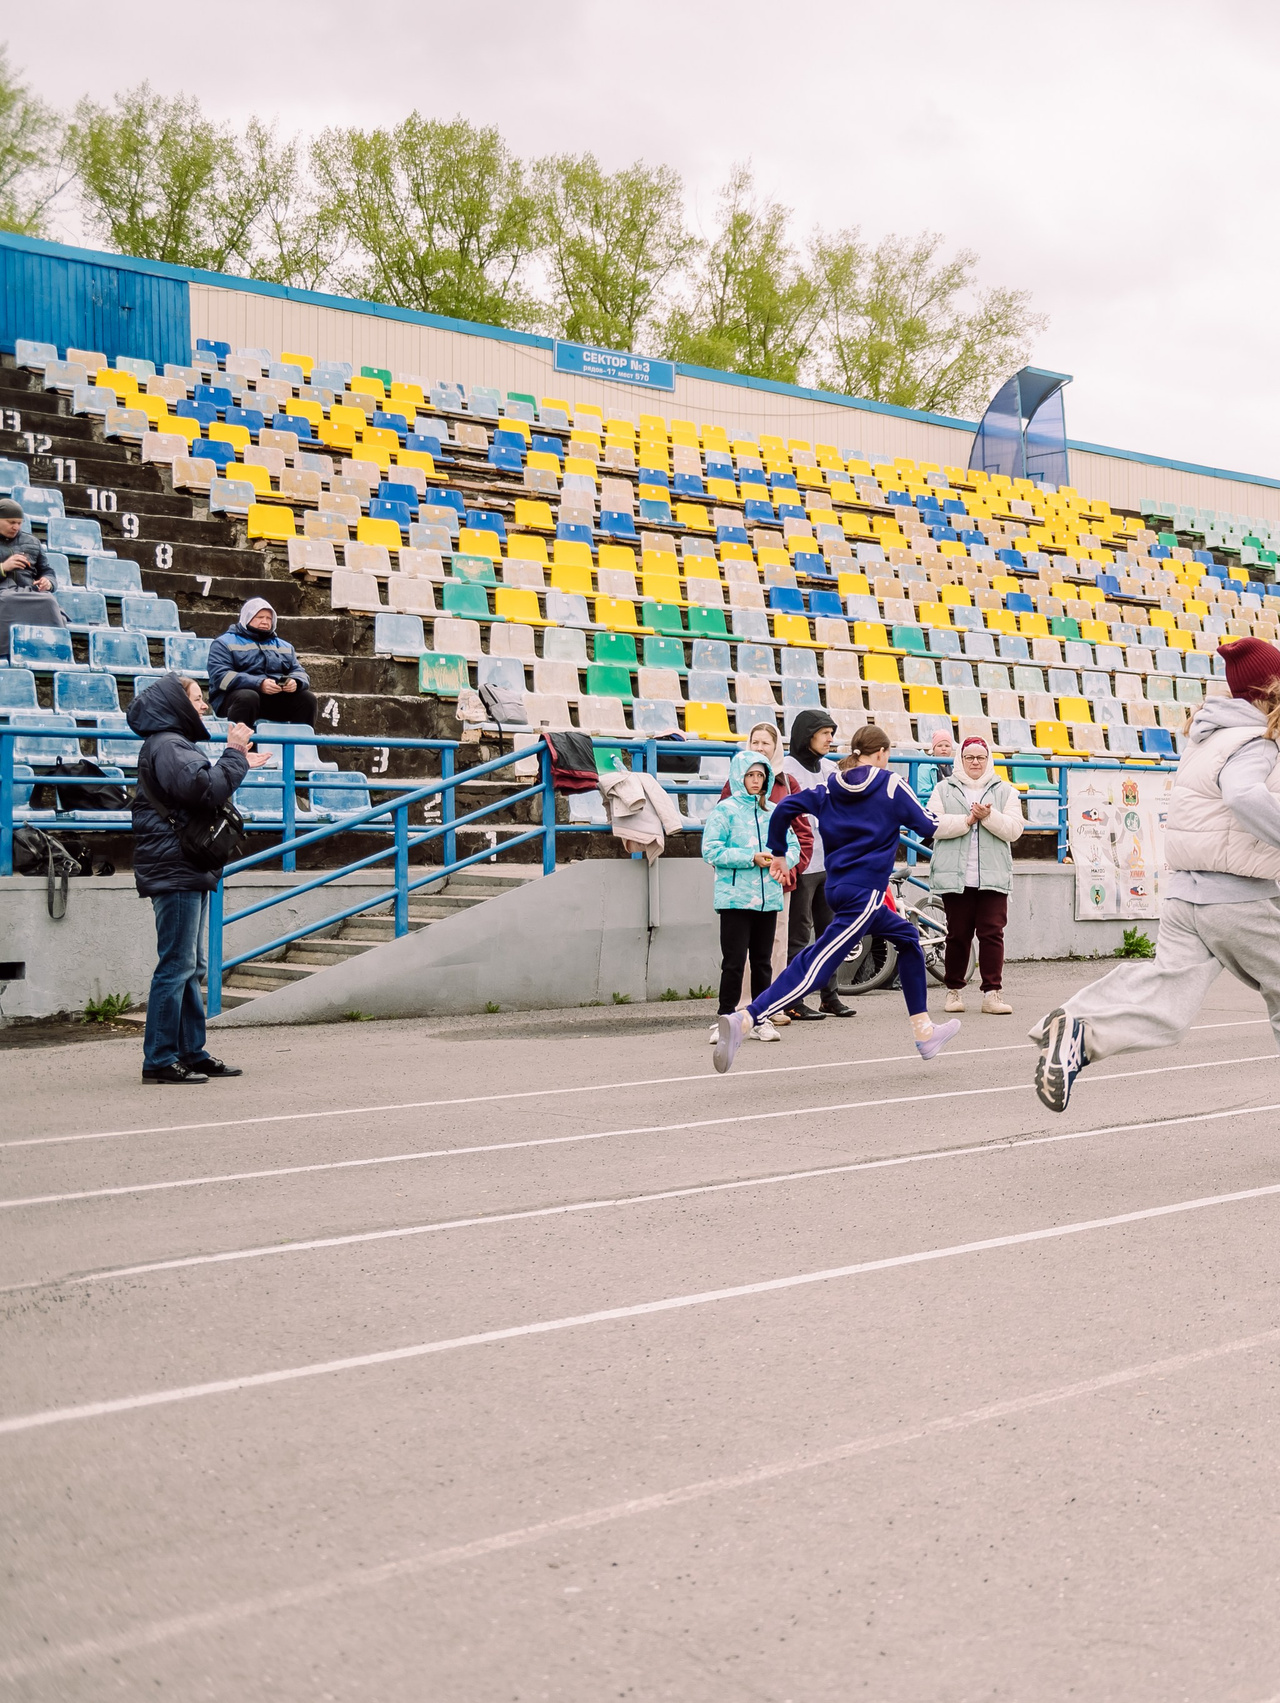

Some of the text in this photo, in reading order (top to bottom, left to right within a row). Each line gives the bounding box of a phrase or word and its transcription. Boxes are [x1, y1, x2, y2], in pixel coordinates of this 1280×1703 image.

[582, 351, 650, 373] СЕКТОР №3
[635, 374, 650, 382] 570
[24, 432, 52, 456] 12
[52, 458, 76, 484] 11
[86, 488, 117, 512] 10
[122, 514, 140, 538] 9
[156, 544, 174, 569] 8
[196, 576, 212, 596] 7
[322, 698, 340, 727] 4
[372, 747, 390, 773] 3
[486, 831, 496, 862] 1
